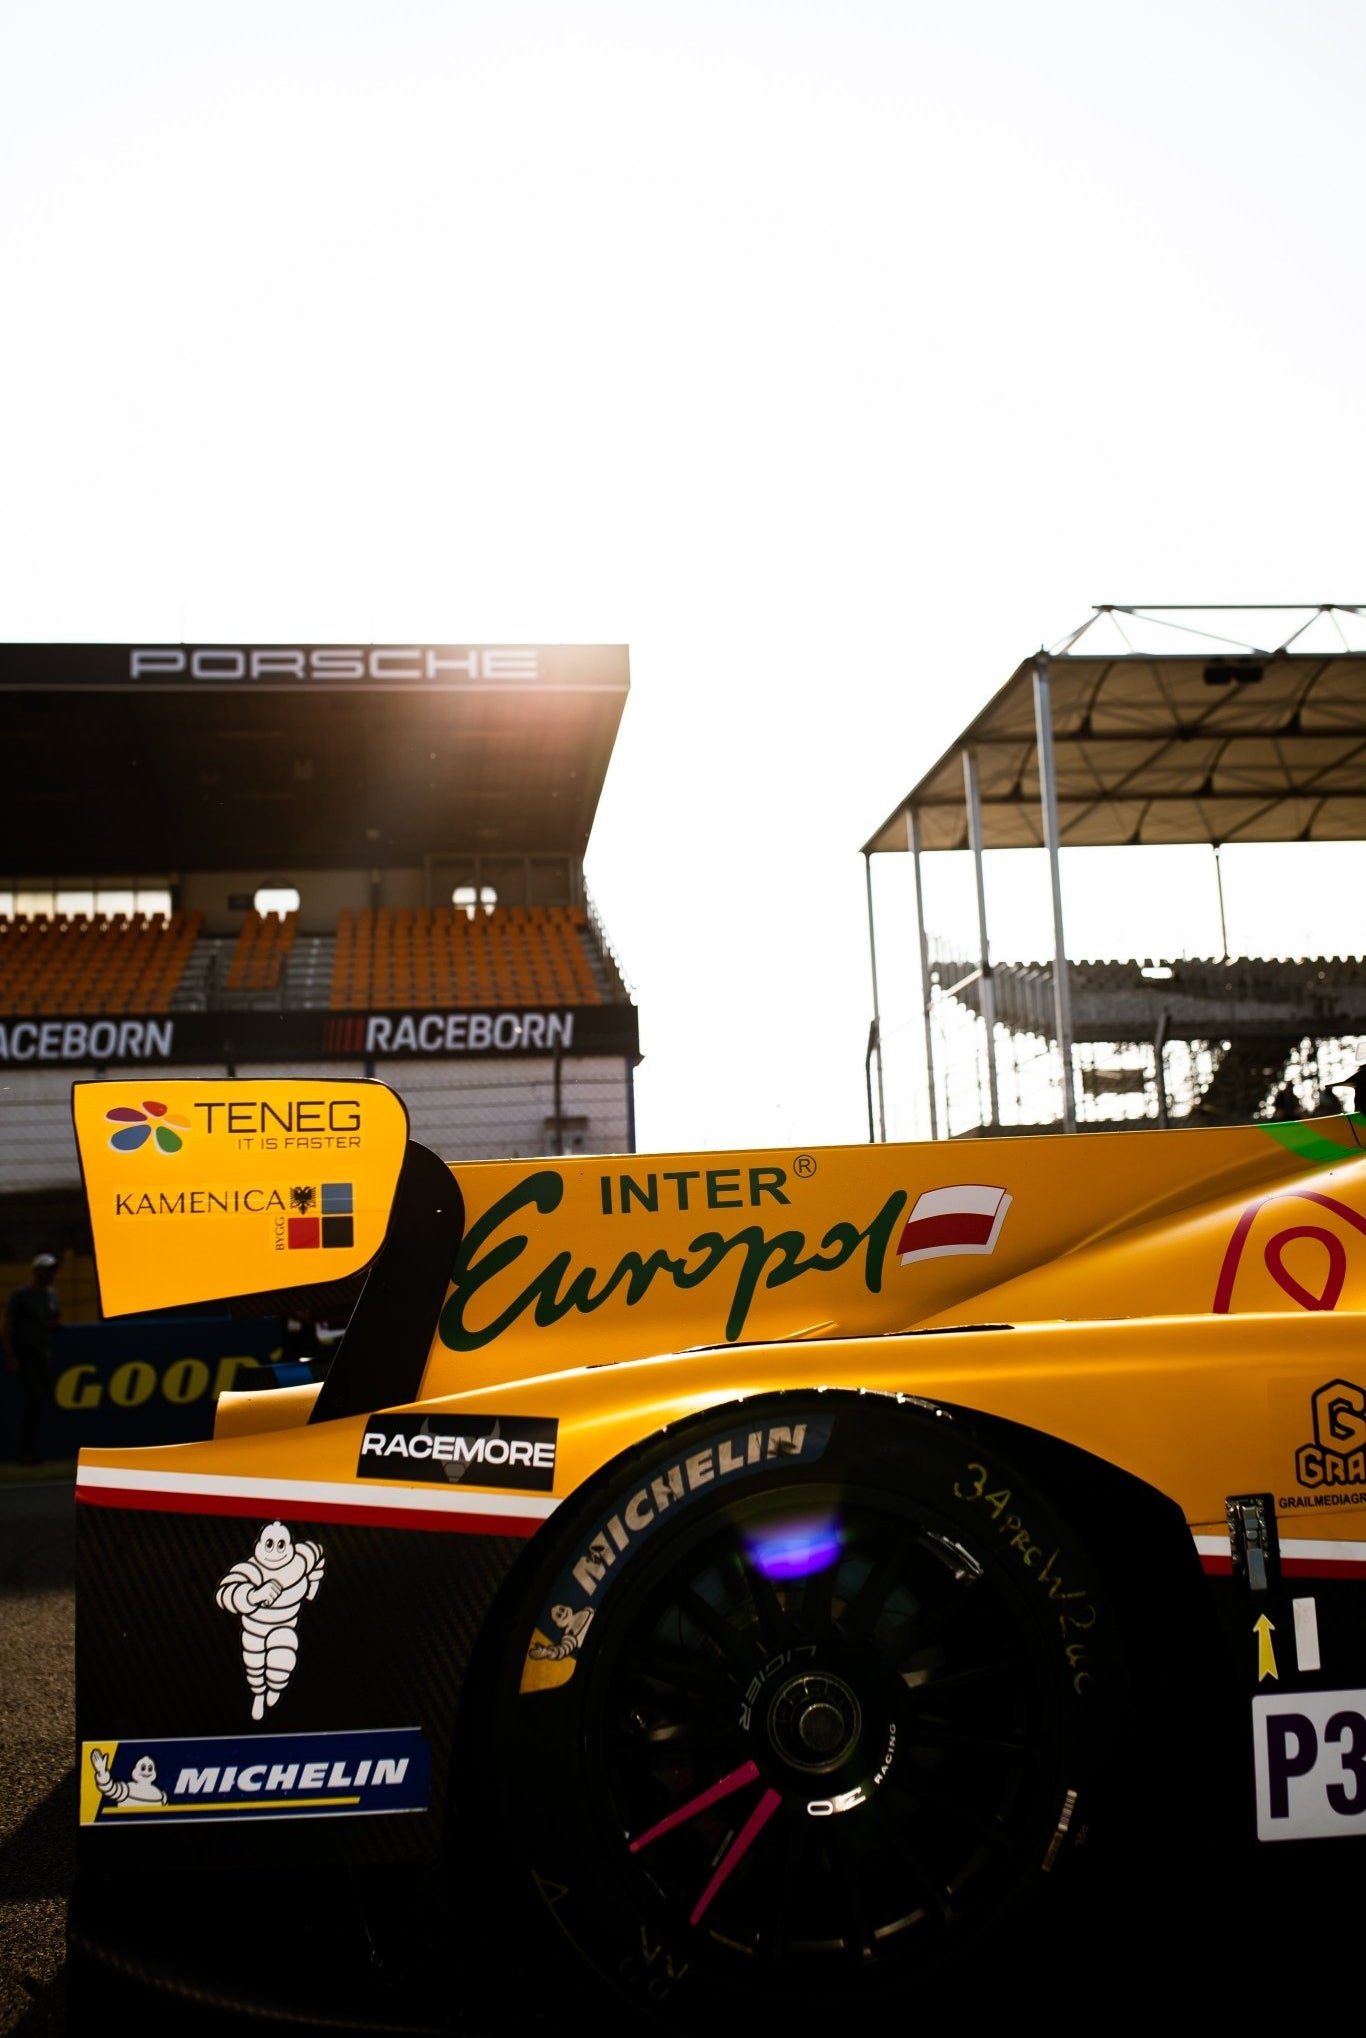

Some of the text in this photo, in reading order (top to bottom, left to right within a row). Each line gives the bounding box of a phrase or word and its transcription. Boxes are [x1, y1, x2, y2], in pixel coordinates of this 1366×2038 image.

[130, 650, 539, 680] PORSCHE
[365, 1013, 574, 1052] RACEBORN
[193, 1100, 361, 1134] TENEG
[238, 1136, 361, 1151] IT IS FASTER
[116, 1189, 286, 1216] KAMENICA
[275, 1216, 286, 1251] BYGG
[438, 1170, 907, 1352] Europol
[361, 1432, 556, 1469] RACEMORE
[572, 1423, 808, 1598] MICHELIN
[873, 1722, 897, 1785] RACING
[1266, 1711, 1366, 1819] P3
[174, 1758, 410, 1796] MICHELIN
